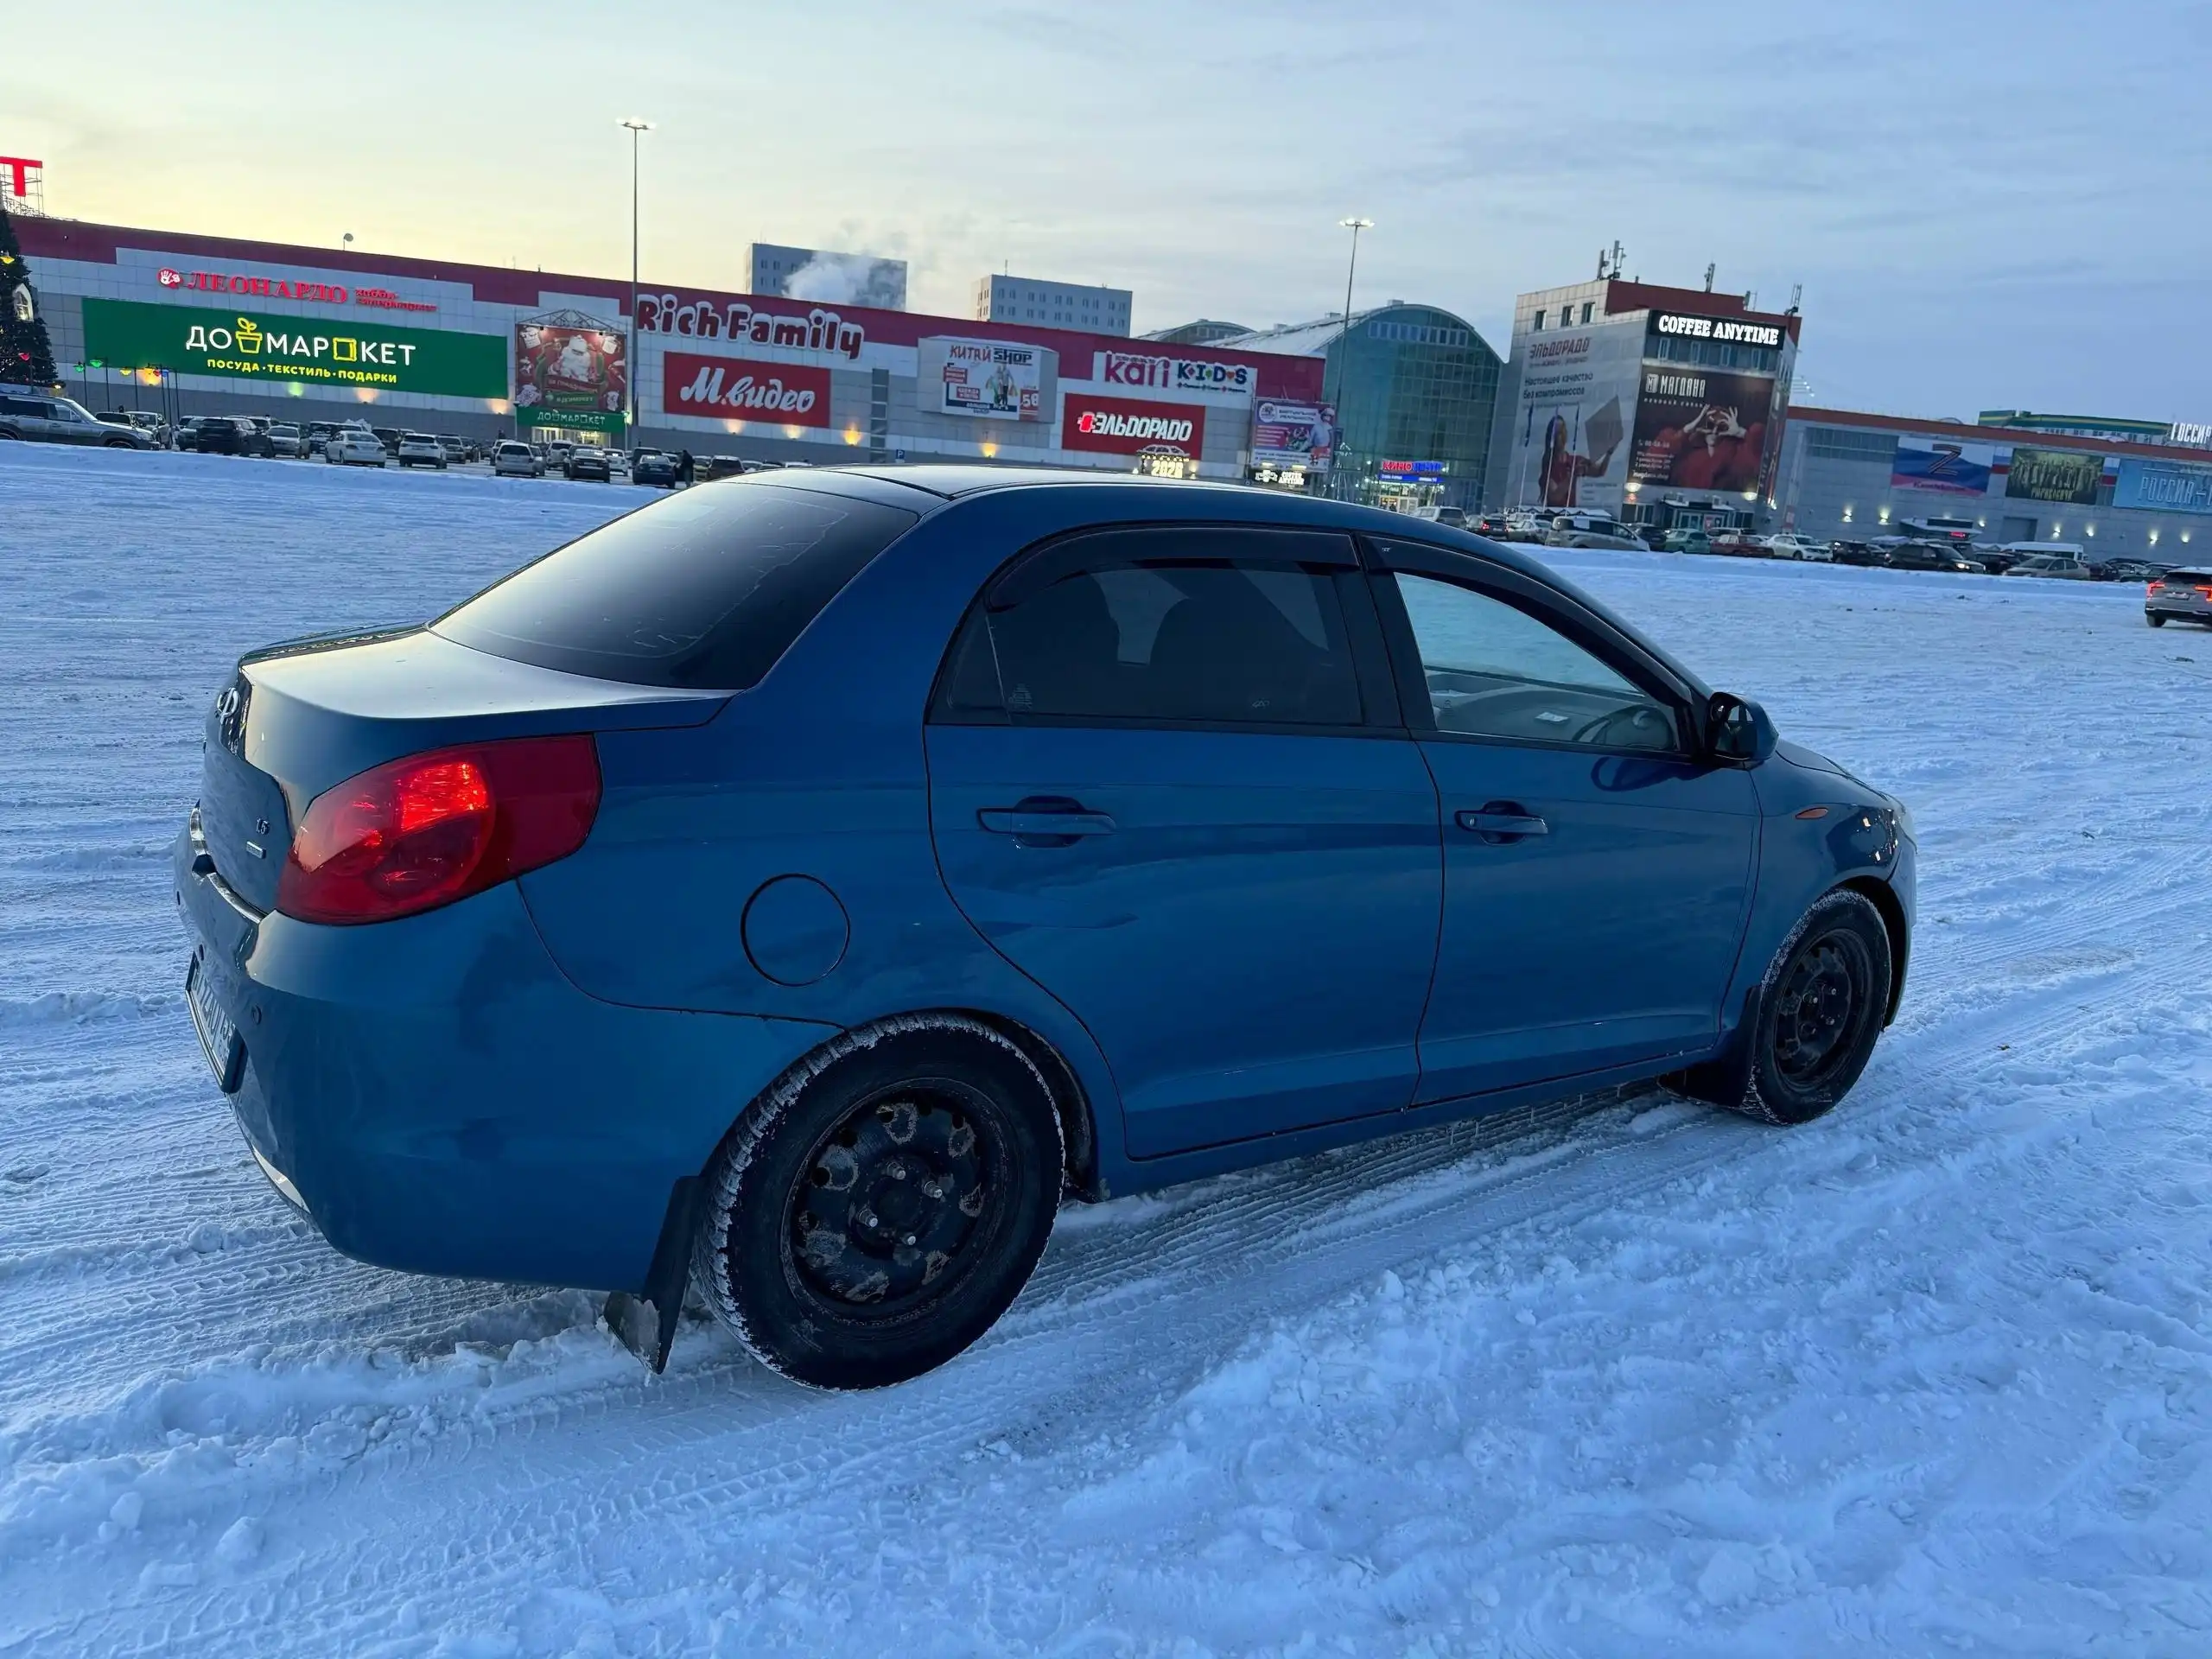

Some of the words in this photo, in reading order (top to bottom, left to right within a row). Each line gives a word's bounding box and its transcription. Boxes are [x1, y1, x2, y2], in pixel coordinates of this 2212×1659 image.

[188, 270, 348, 304] ЛЕОНАРДО
[637, 294, 721, 339] Rich
[726, 302, 864, 361] Family
[1658, 315, 1712, 338] COFFEE
[1713, 321, 1780, 346] ANYTIME
[949, 345, 992, 362] КИТАЙ
[994, 347, 1033, 365] SHOP
[207, 359, 259, 372] ПОСУДА
[267, 364, 331, 378] ТЕКСТИЛЬ
[338, 369, 397, 383] ПОДАРКИ
[1104, 352, 1171, 388] kari
[680, 366, 815, 413] М.видео
[1660, 374, 1706, 398] МАГДАНА
[2139, 476, 2196, 505] РОССИЯ
